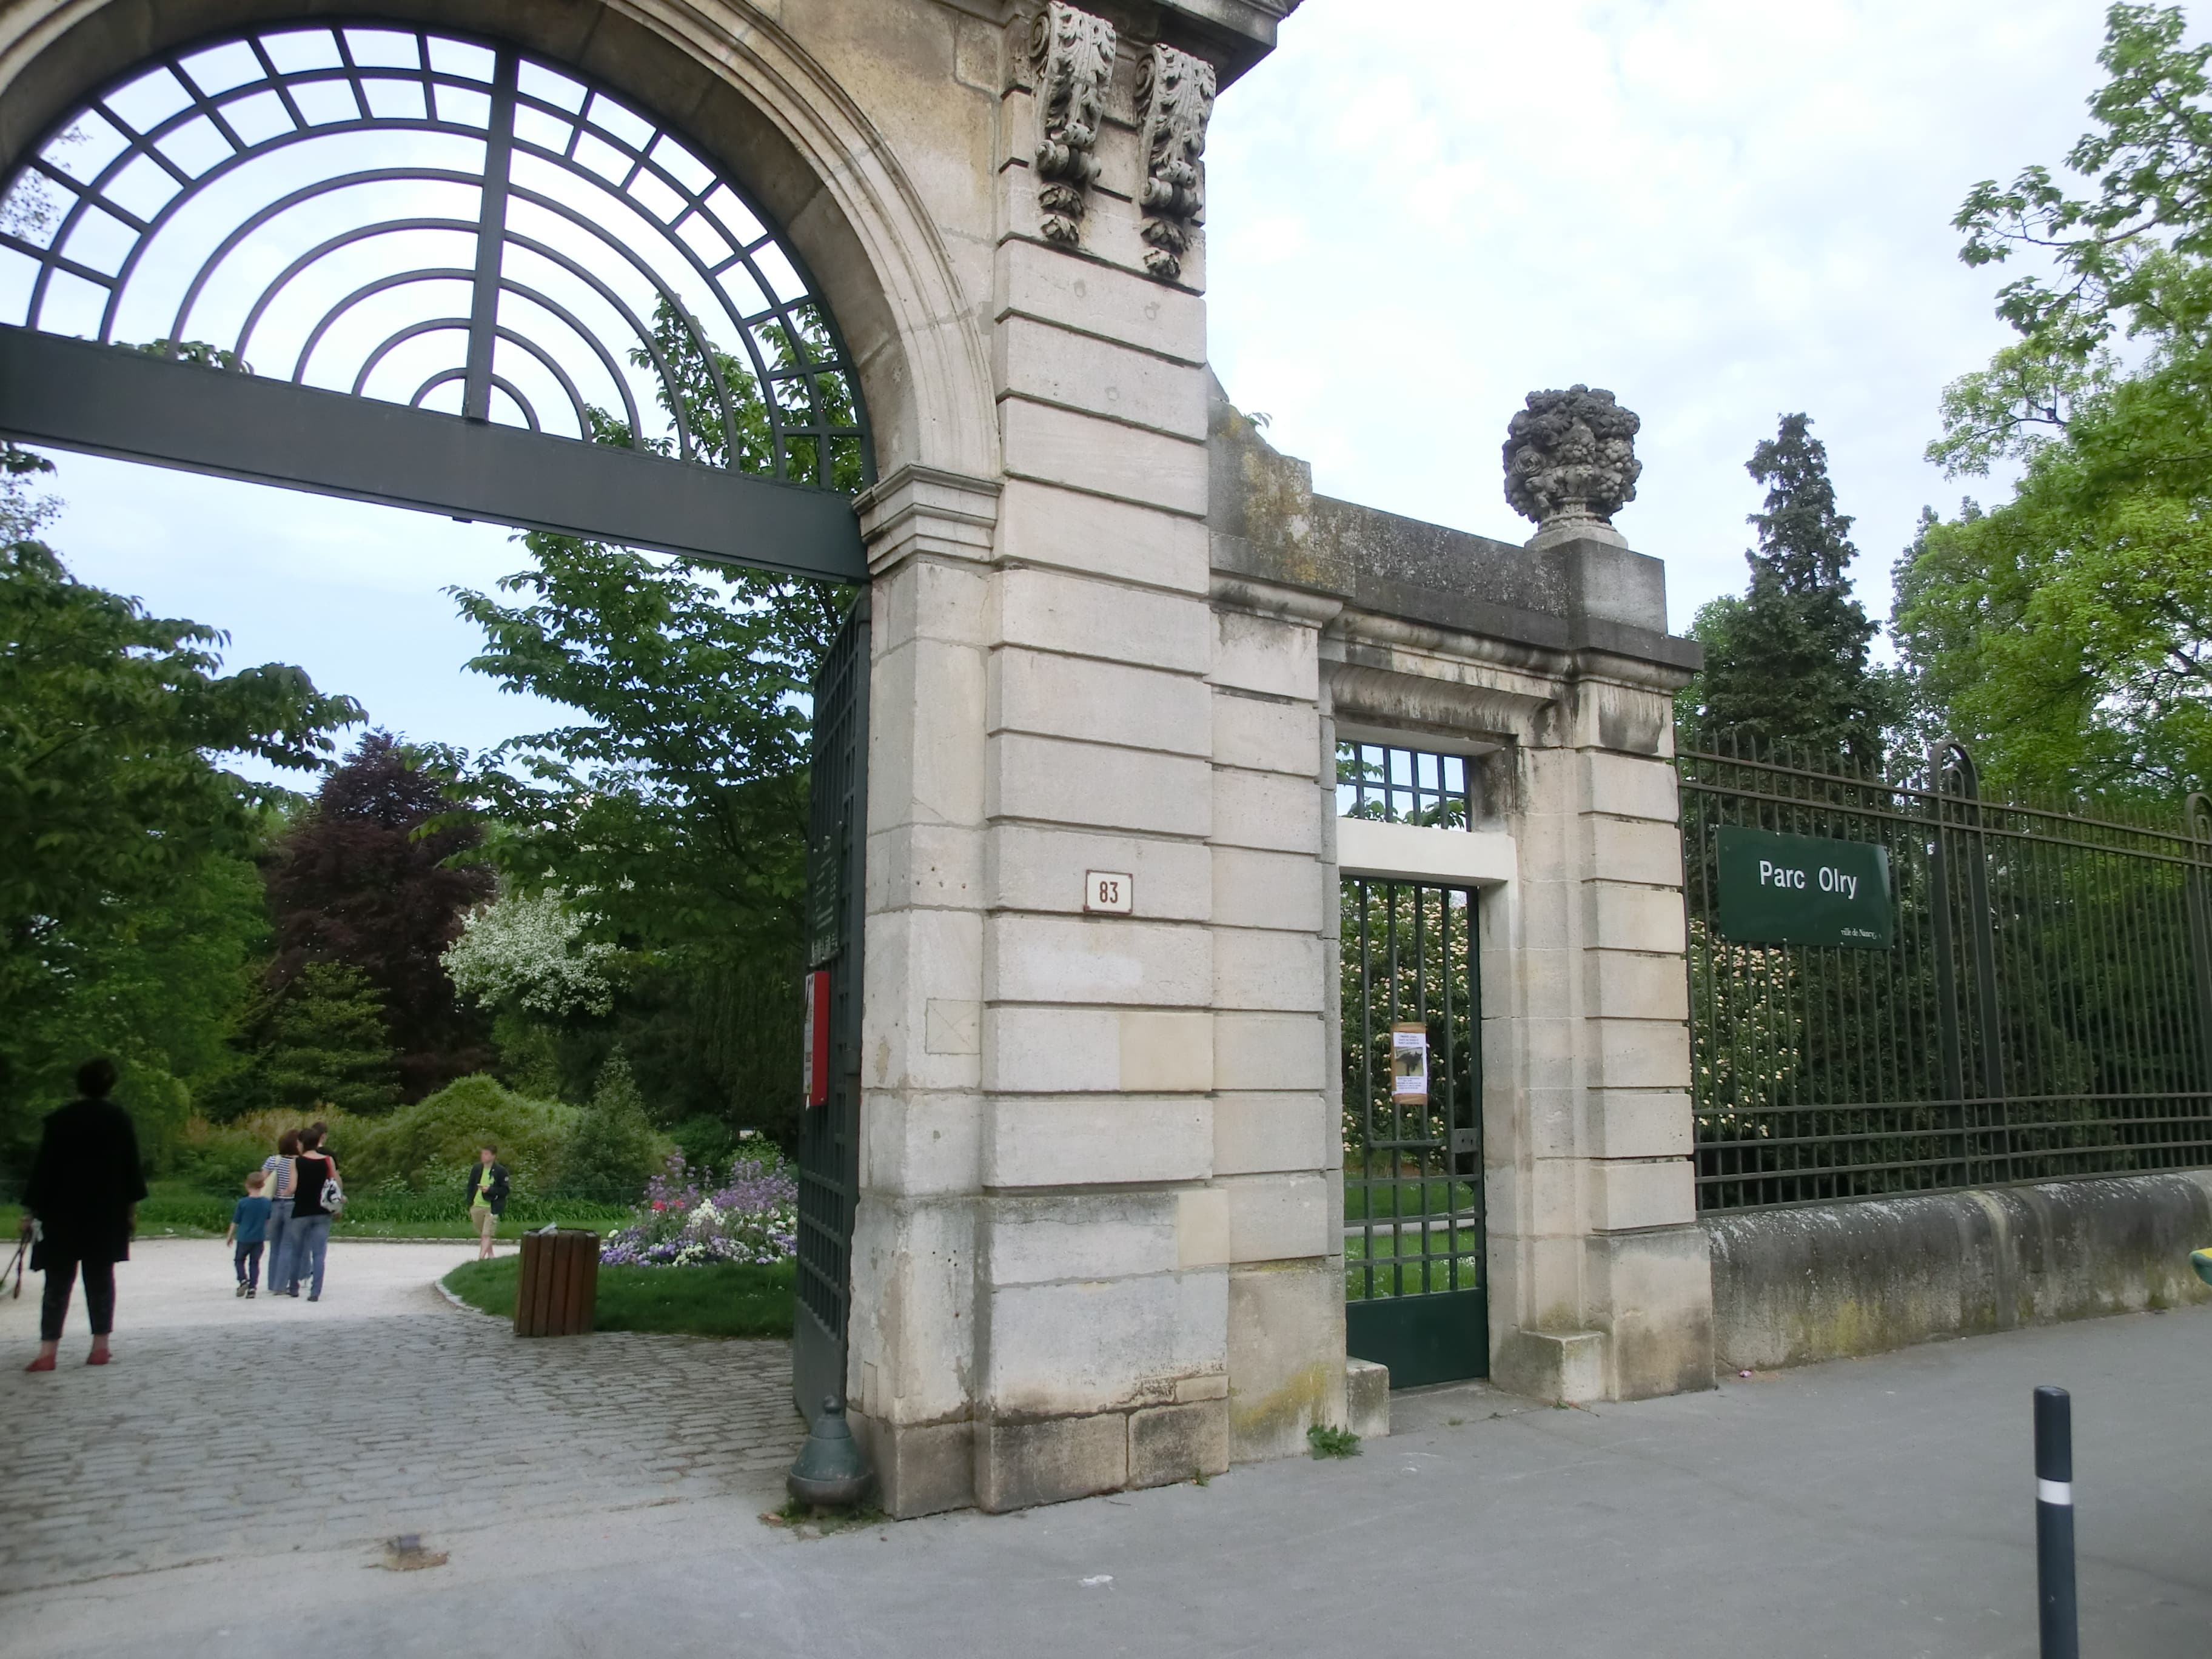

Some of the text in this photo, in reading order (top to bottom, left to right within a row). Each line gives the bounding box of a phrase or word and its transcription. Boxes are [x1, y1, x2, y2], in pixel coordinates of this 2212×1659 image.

[1759, 860, 1857, 900] Parc Olry
[1099, 881, 1118, 903] 83
[1852, 928, 1858, 936] de
